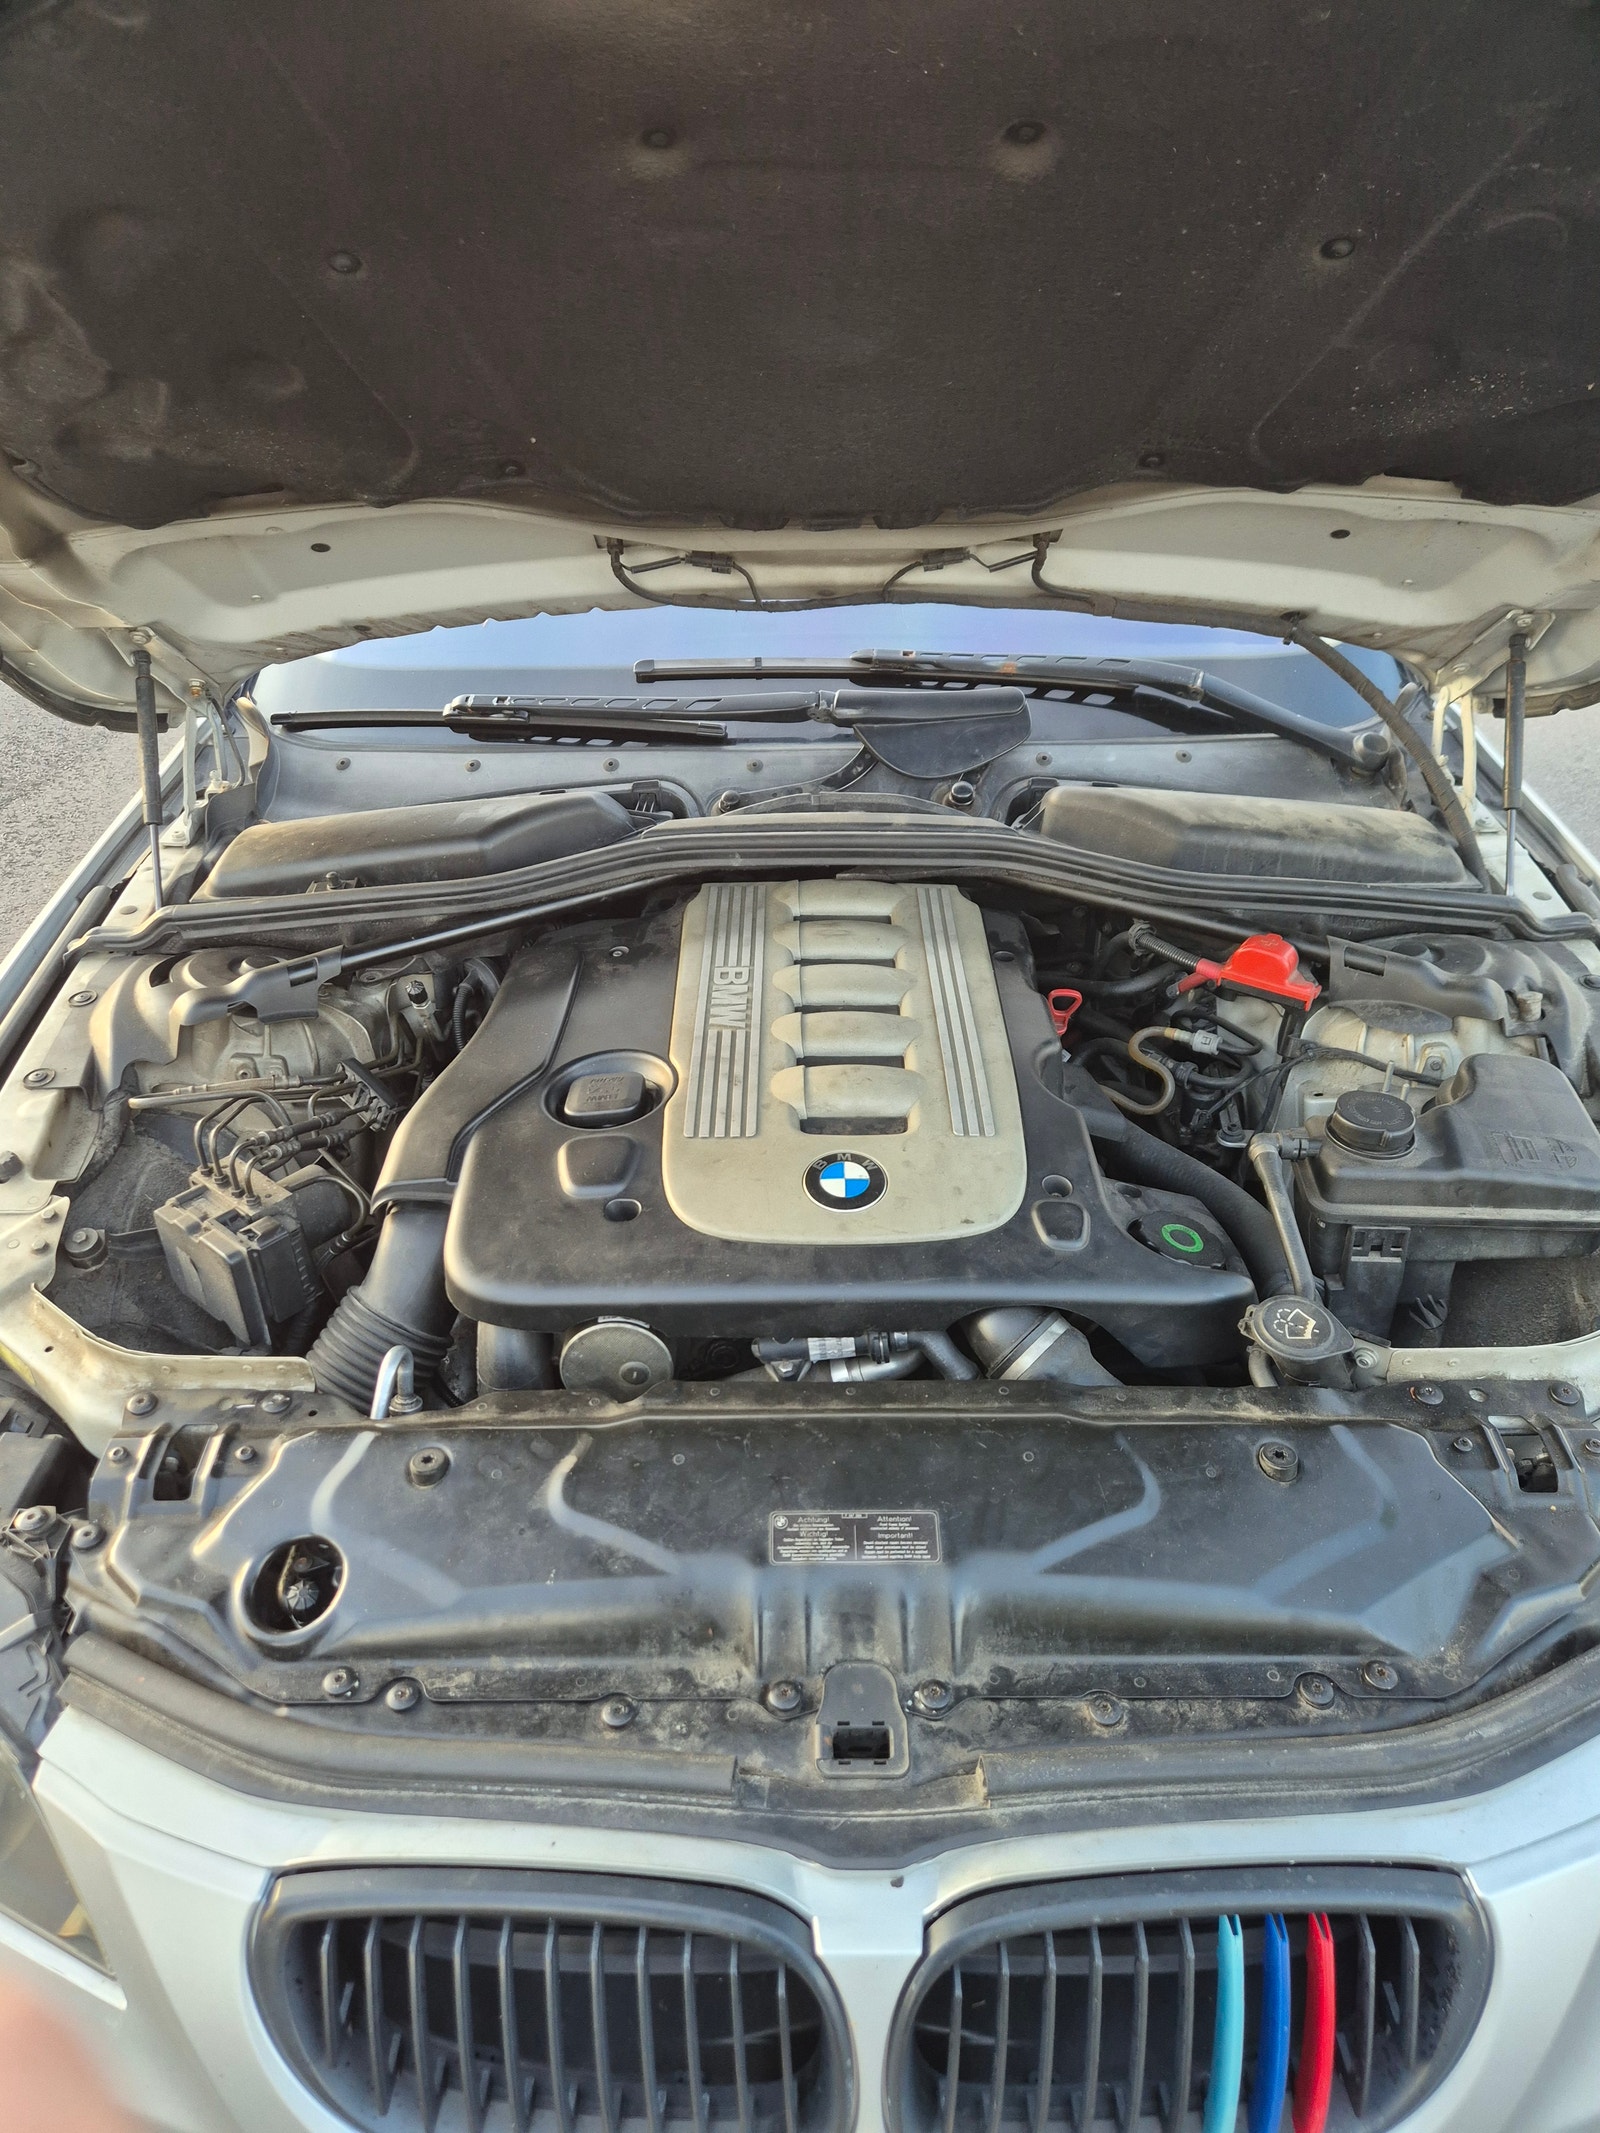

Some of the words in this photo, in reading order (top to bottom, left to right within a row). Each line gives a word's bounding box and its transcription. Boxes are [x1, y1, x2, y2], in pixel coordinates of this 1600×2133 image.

[709, 967, 750, 1029] BMW
[812, 1153, 878, 1171] BMW
[797, 1516, 829, 1524] Achtung!
[877, 1532, 913, 1540] Important!
